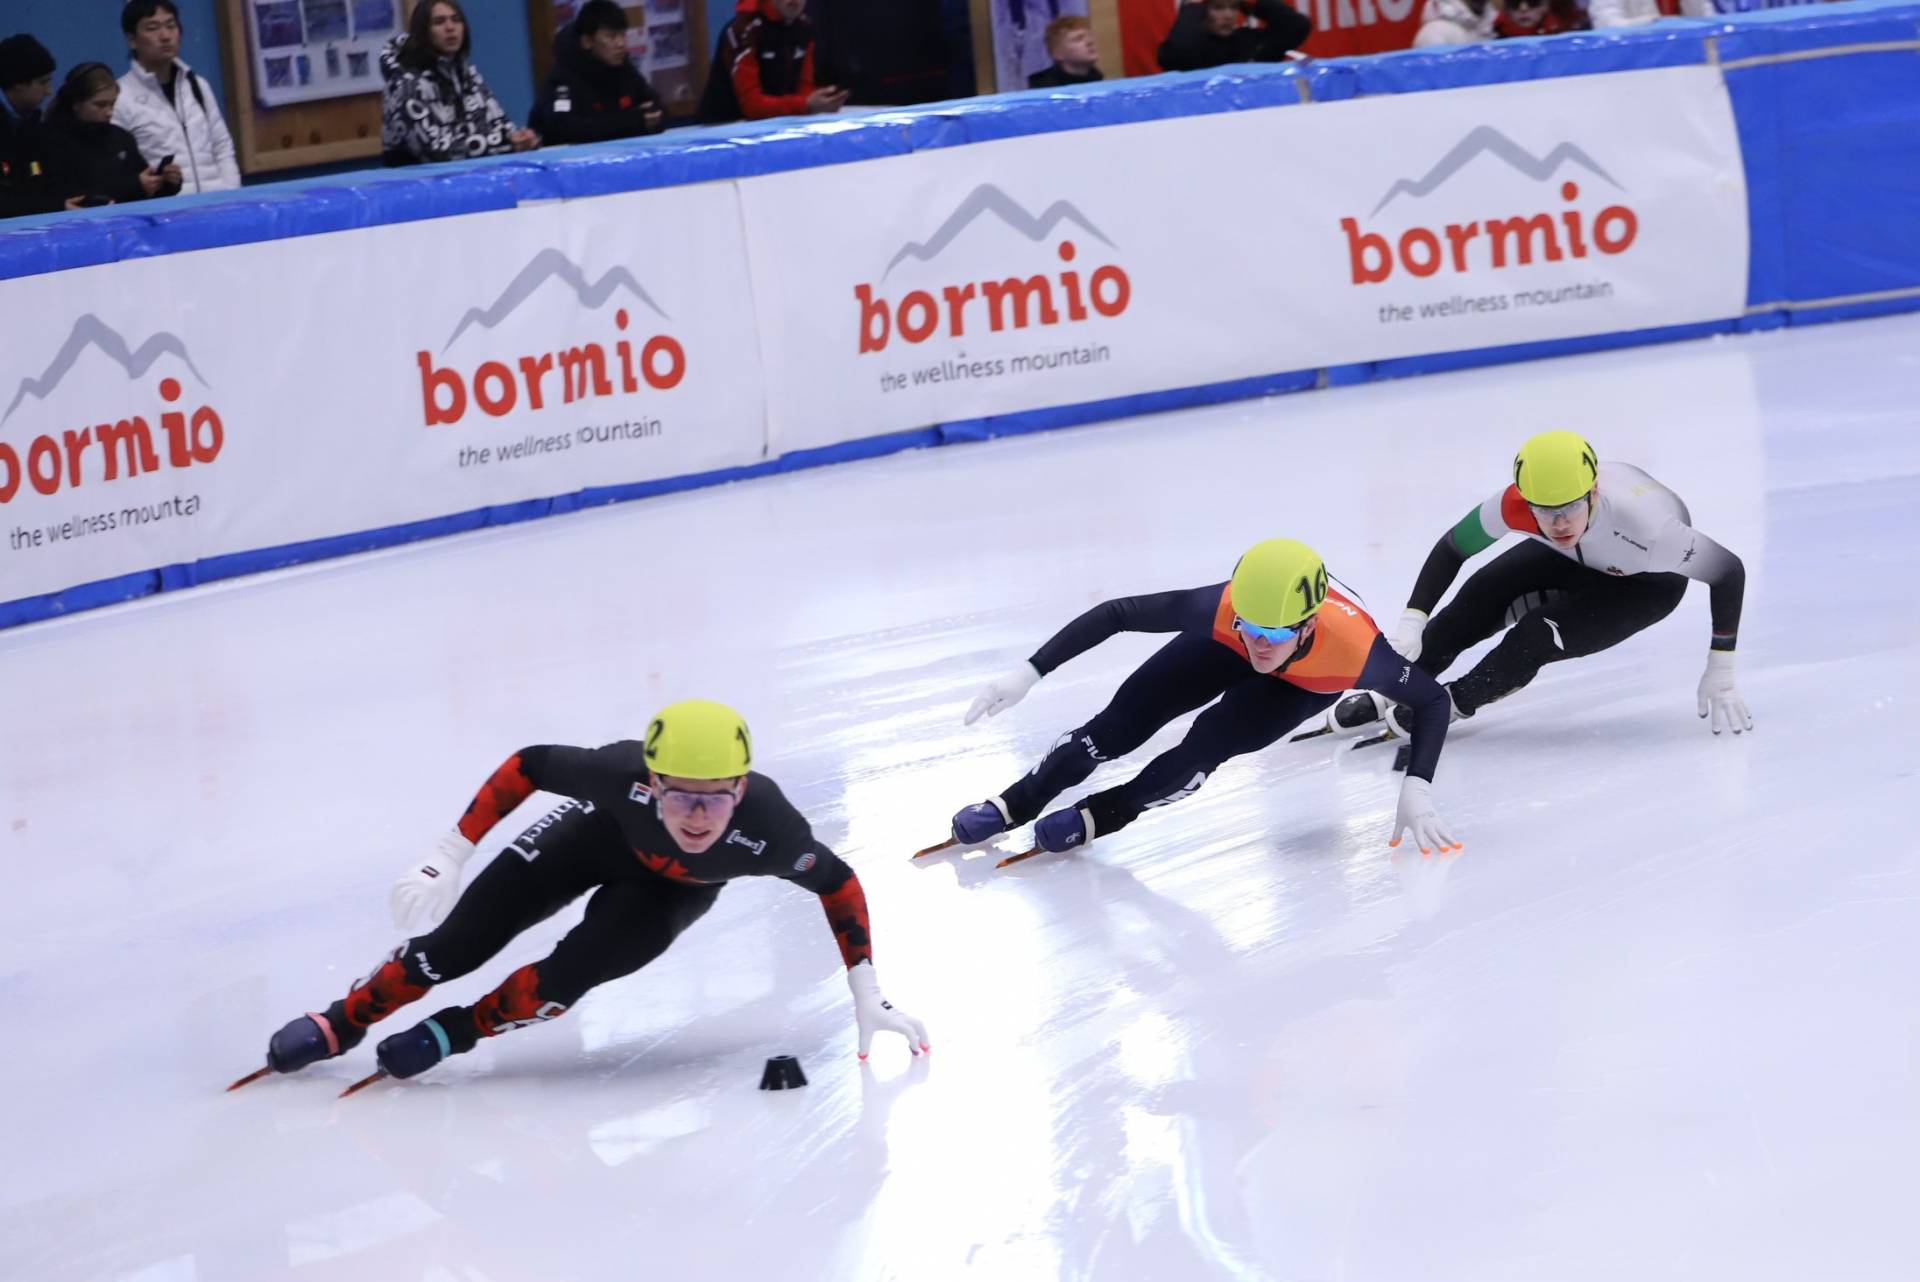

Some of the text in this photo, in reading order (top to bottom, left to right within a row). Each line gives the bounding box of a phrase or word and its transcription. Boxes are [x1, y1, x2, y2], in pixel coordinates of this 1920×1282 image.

[1340, 182, 1638, 285] bormio
[855, 241, 1132, 353] bormio
[1380, 280, 1613, 324] the wellness mountain
[418, 309, 685, 426] bormio
[880, 342, 1111, 393] the wellness mountain
[459, 416, 662, 468] the wellness ountain
[10, 526, 43, 551] the
[47, 511, 118, 543] wellness
[1296, 565, 1328, 616] 16
